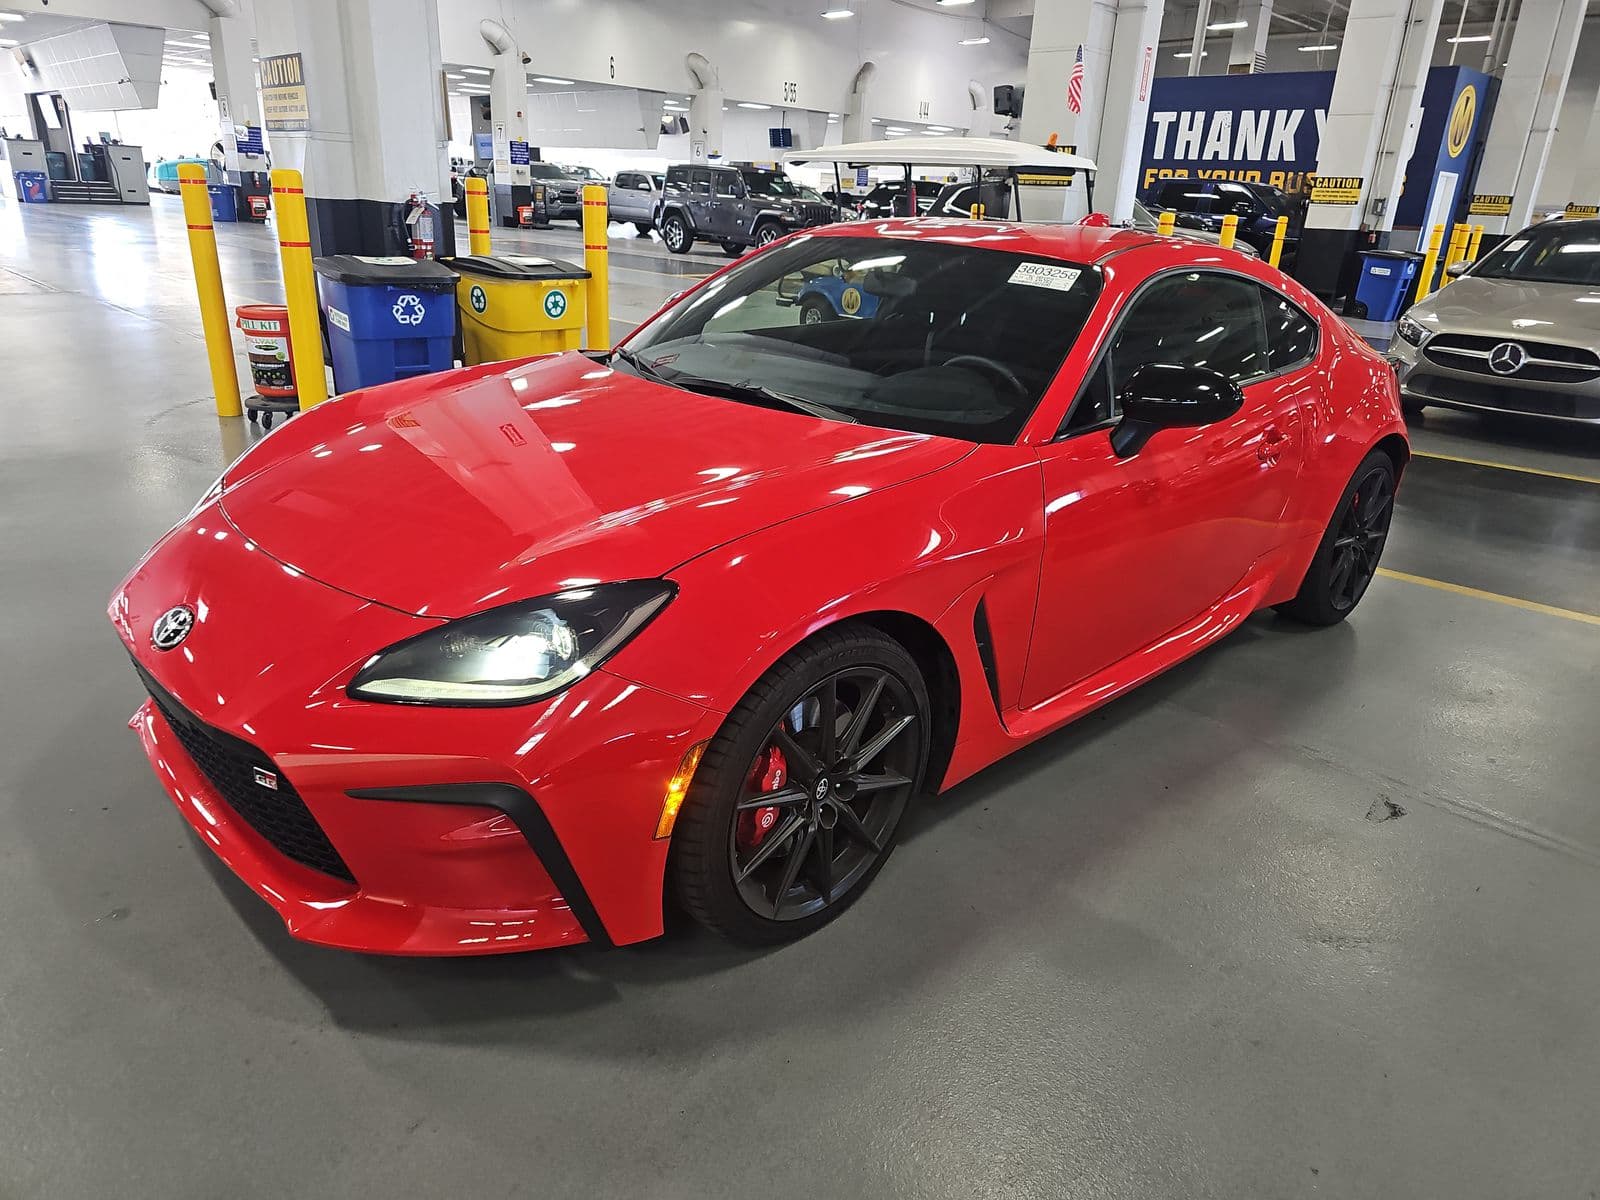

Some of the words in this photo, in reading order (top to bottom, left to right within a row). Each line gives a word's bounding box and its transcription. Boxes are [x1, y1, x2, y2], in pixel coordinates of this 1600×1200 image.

[261, 57, 301, 86] CAUTION
[610, 56, 615, 79] 6
[1152, 109, 1305, 162] THANK
[1315, 177, 1360, 188] CAUTION
[1473, 195, 1511, 204] CAUTION
[1566, 205, 1597, 213] CAUTION
[260, 321, 278, 331] KIT
